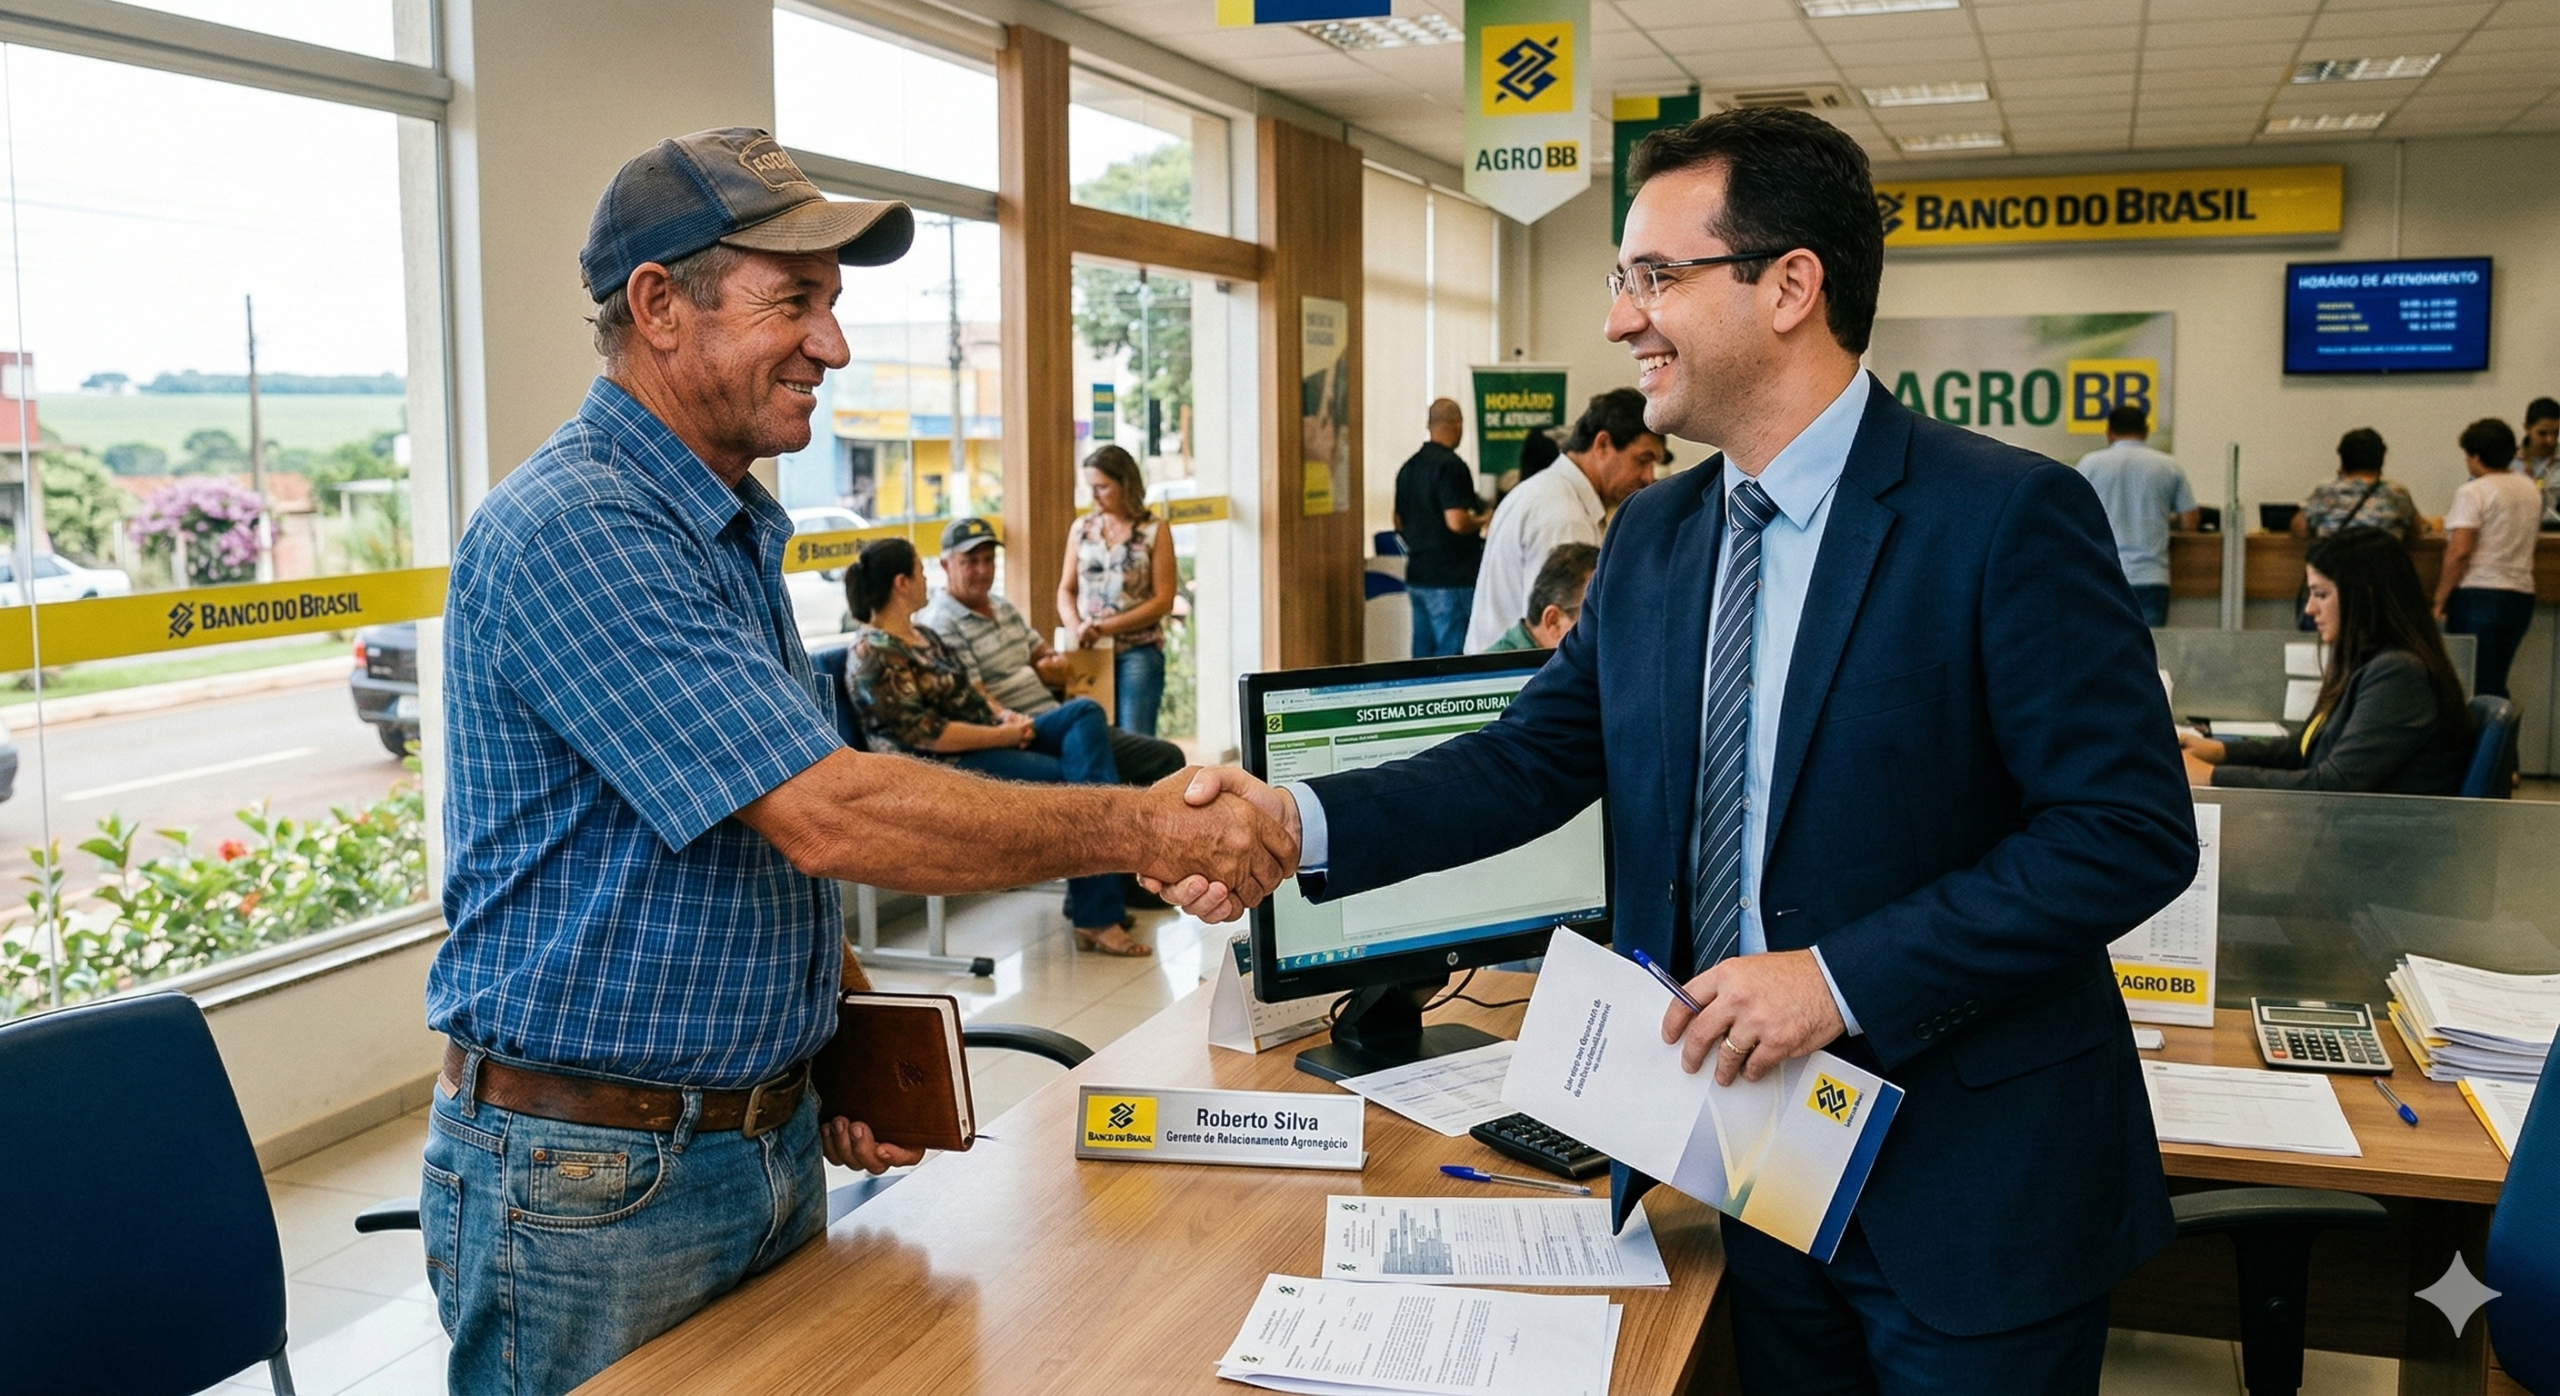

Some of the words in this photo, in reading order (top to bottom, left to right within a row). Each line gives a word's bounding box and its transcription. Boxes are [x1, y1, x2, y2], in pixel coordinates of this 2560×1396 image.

[1475, 146, 1542, 171] AGRO
[1546, 146, 1577, 168] BB
[1916, 194, 2048, 231] BANCO
[2056, 193, 2108, 227] DO
[2115, 187, 2256, 224] BRASIL
[1893, 368, 2061, 427] AGRO
[2073, 371, 2153, 422] BB
[201, 601, 270, 630] BANCO
[273, 599, 297, 622] DO
[300, 592, 362, 618] BRASIL
[1356, 705, 1406, 723] SISTEMA
[1409, 703, 1424, 718] DE
[1426, 699, 1475, 716] CRÉDITO
[1476, 696, 1511, 711] RURAL
[2121, 974, 2168, 992] AGRO
[2170, 977, 2196, 994] BB
[1196, 1108, 1268, 1129] Roberto
[1274, 1111, 1319, 1131] Silva
[1166, 1130, 1201, 1143] Gerente
[1203, 1132, 1215, 1144] de
[1217, 1132, 1289, 1147] Relacionamento
[1291, 1136, 1348, 1151] Agronegócio
